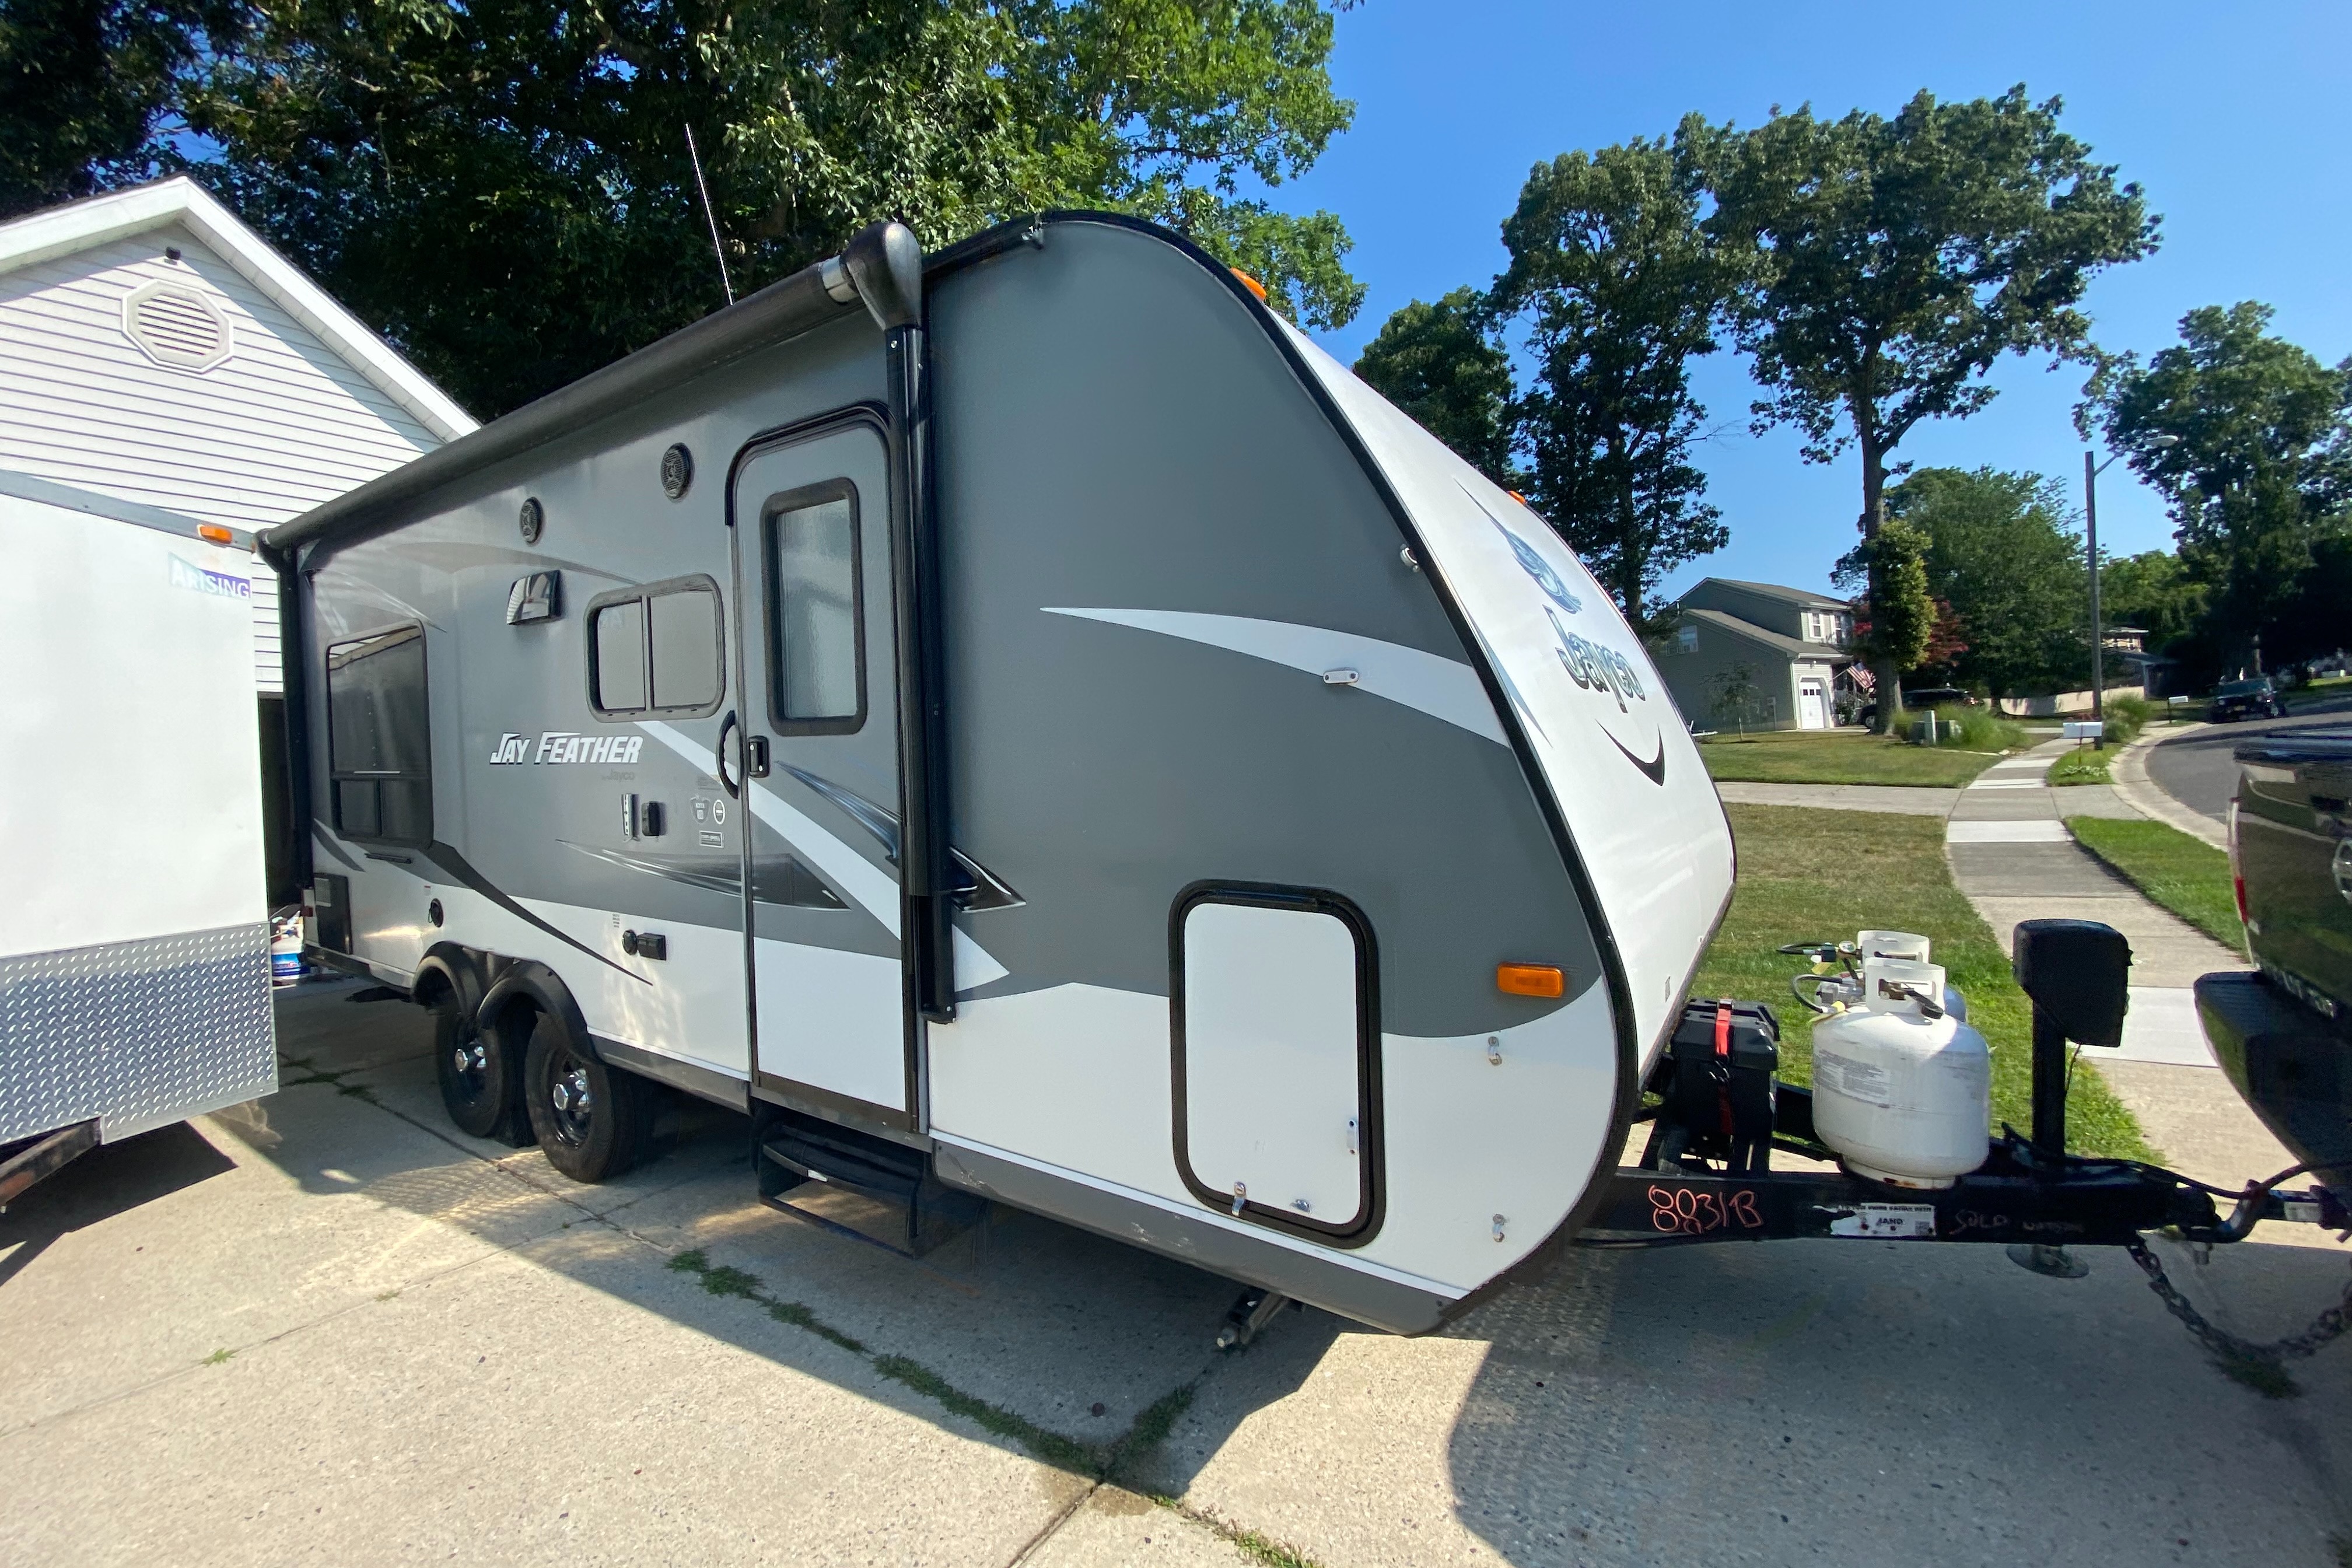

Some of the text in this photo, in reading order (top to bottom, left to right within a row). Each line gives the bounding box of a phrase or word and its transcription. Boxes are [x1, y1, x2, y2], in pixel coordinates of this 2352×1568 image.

[1542, 604, 1646, 713] Jayco
[489, 731, 643, 765] JAY FEATHER
